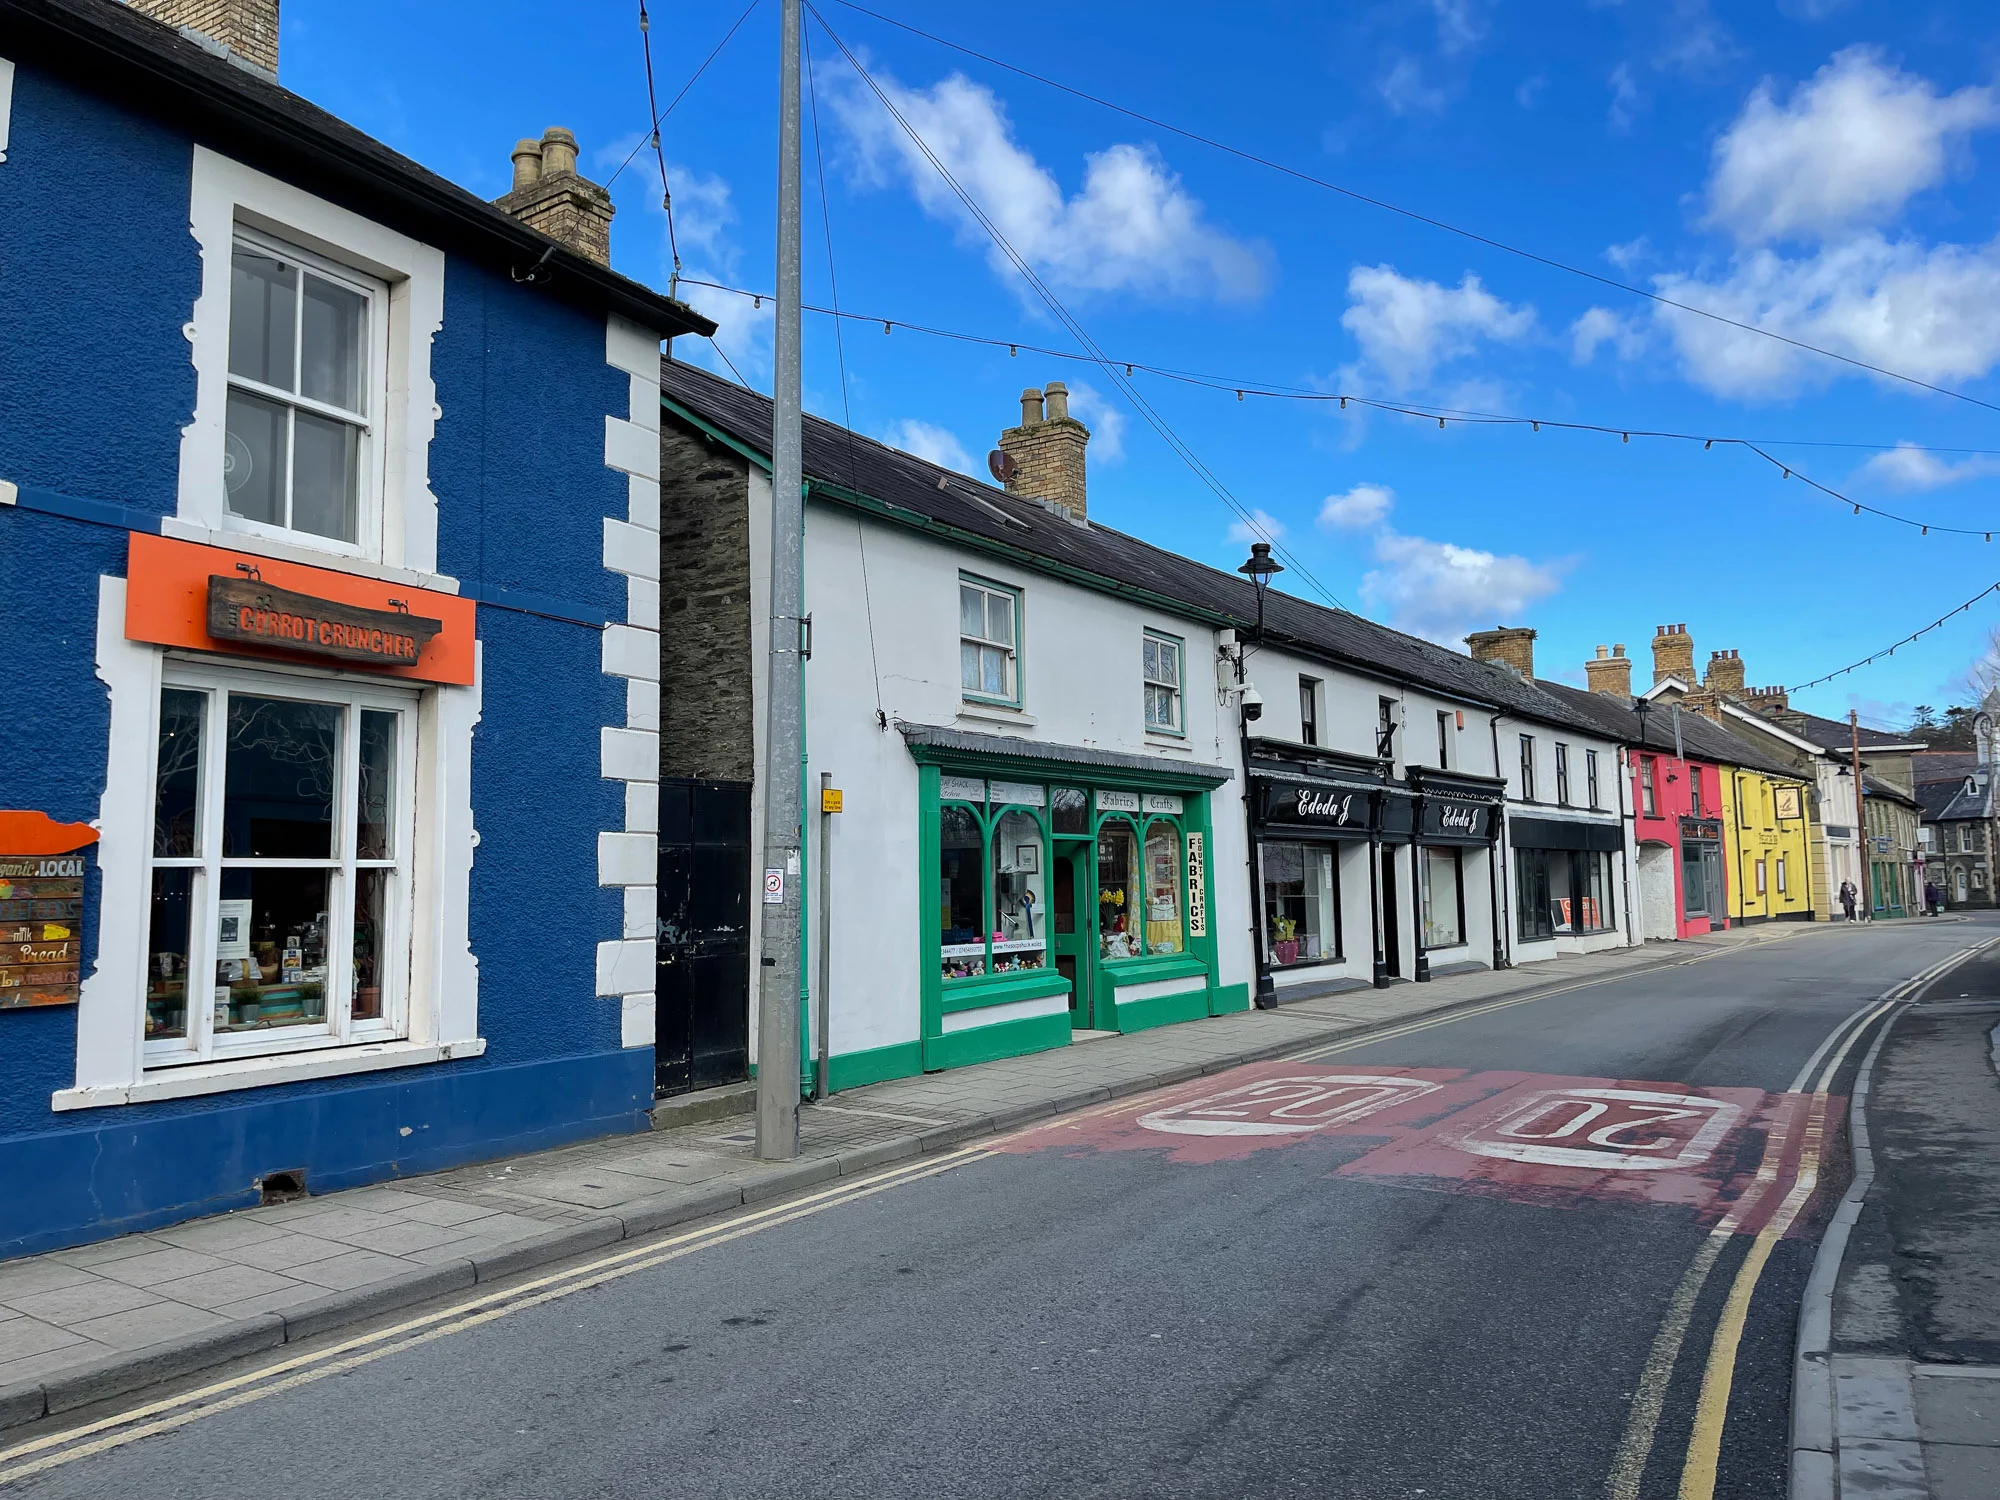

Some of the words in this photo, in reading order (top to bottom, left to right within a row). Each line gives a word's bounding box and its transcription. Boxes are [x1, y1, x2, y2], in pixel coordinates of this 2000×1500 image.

[239, 605, 317, 642] CARROT
[318, 620, 415, 659] CRUNCHER
[1102, 791, 1135, 808] Fabrics
[1150, 795, 1174, 811] Crafts
[1297, 789, 1338, 816] Ededa
[1442, 805, 1469, 827] Ededa
[40, 860, 84, 877] LOCAL
[1188, 838, 1200, 931] FABRICS
[20, 942, 69, 962] Bread
[1187, 1084, 1402, 1119] 20
